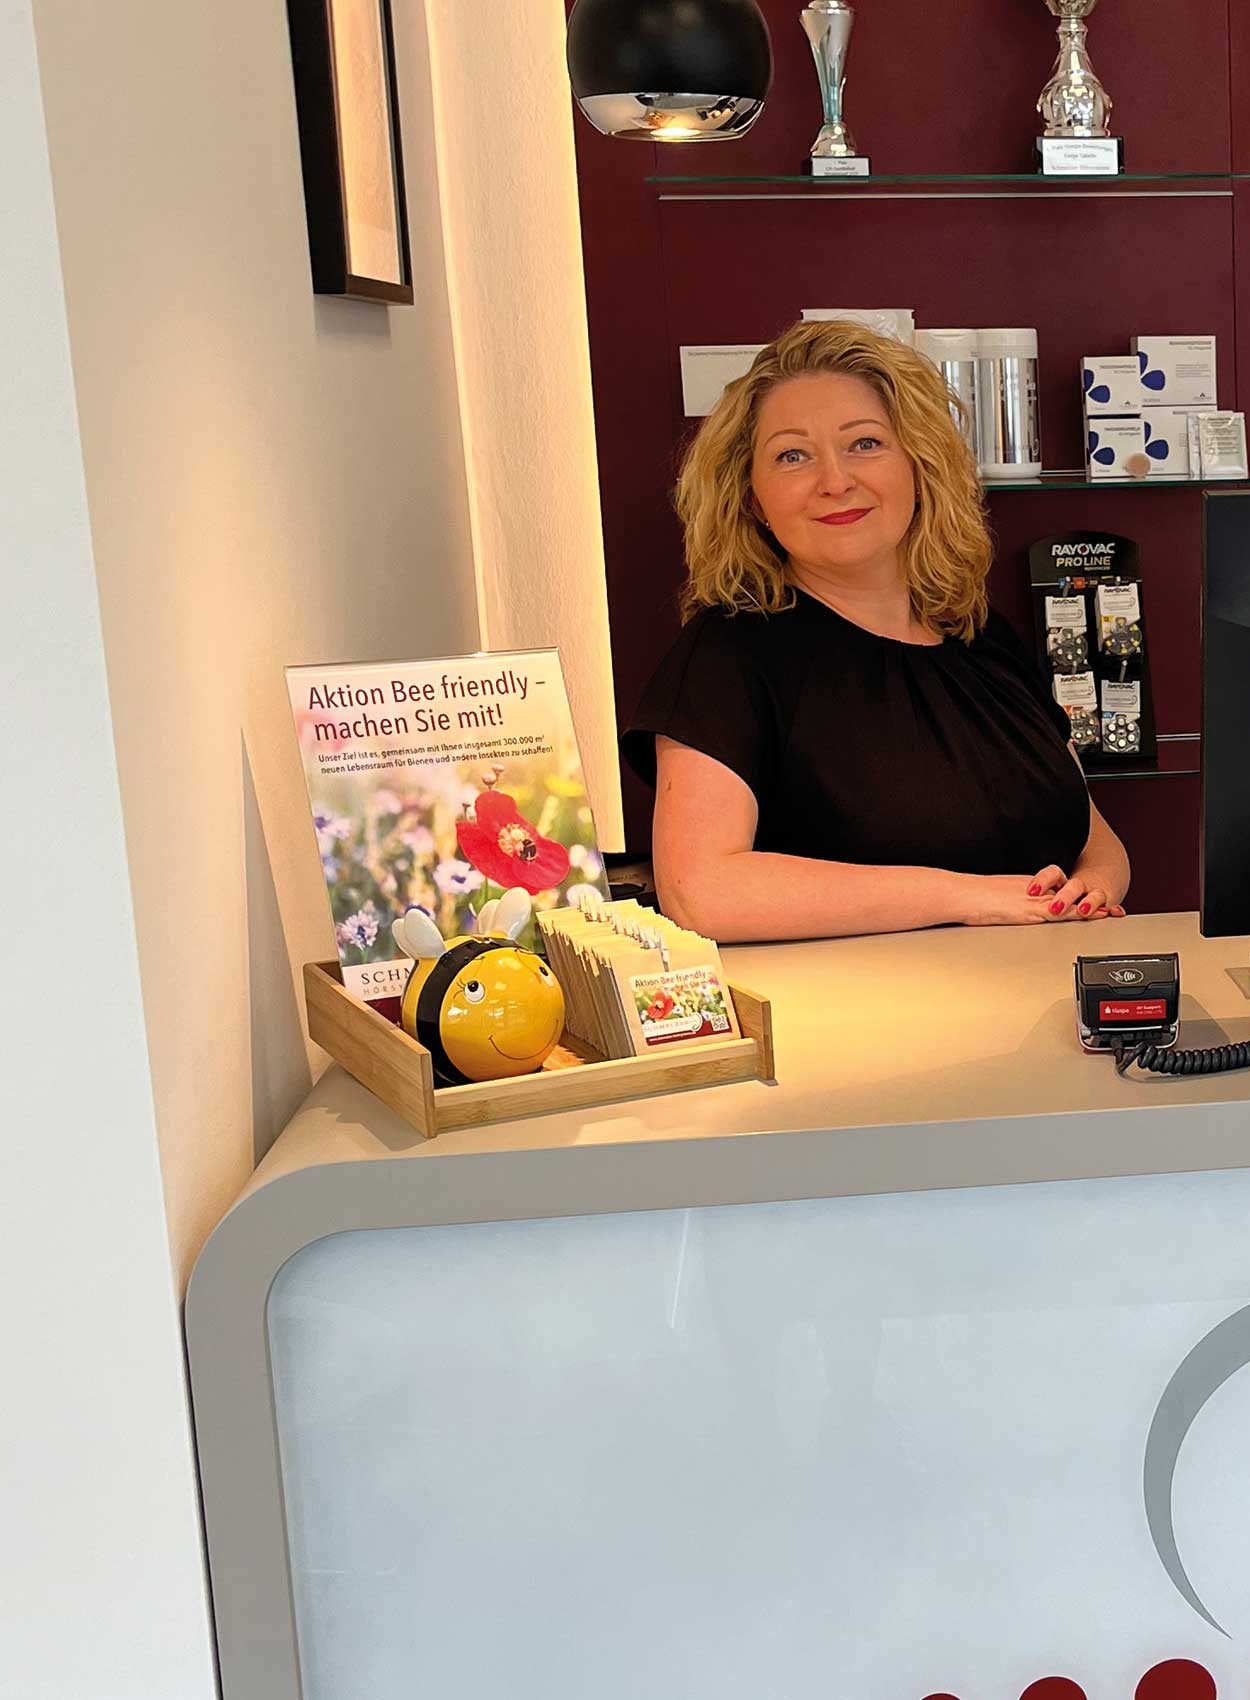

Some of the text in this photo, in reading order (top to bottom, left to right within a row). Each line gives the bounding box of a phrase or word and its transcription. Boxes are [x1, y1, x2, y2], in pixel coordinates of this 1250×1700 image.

[1051, 543, 1116, 556] RAYOVAC
[309, 685, 385, 710] Aktion
[391, 680, 435, 703] Bee
[441, 671, 528, 700] friendly
[314, 703, 505, 741] machen Sie mit!
[318, 754, 341, 763] Unser
[343, 752, 357, 761] Ziel
[358, 751, 368, 759] ist
[381, 746, 425, 759] gemeinsam
[427, 744, 440, 753] mit
[440, 743, 463, 752] Ihnen
[464, 739, 501, 750] insgesamt
[503, 735, 534, 746] 300.000
[321, 745, 554, 774] neuen Lebensraum für Bienen und andere Insekten zu schaffen!
[635, 978, 659, 988] Aktion
[675, 970, 706, 983] friendly
